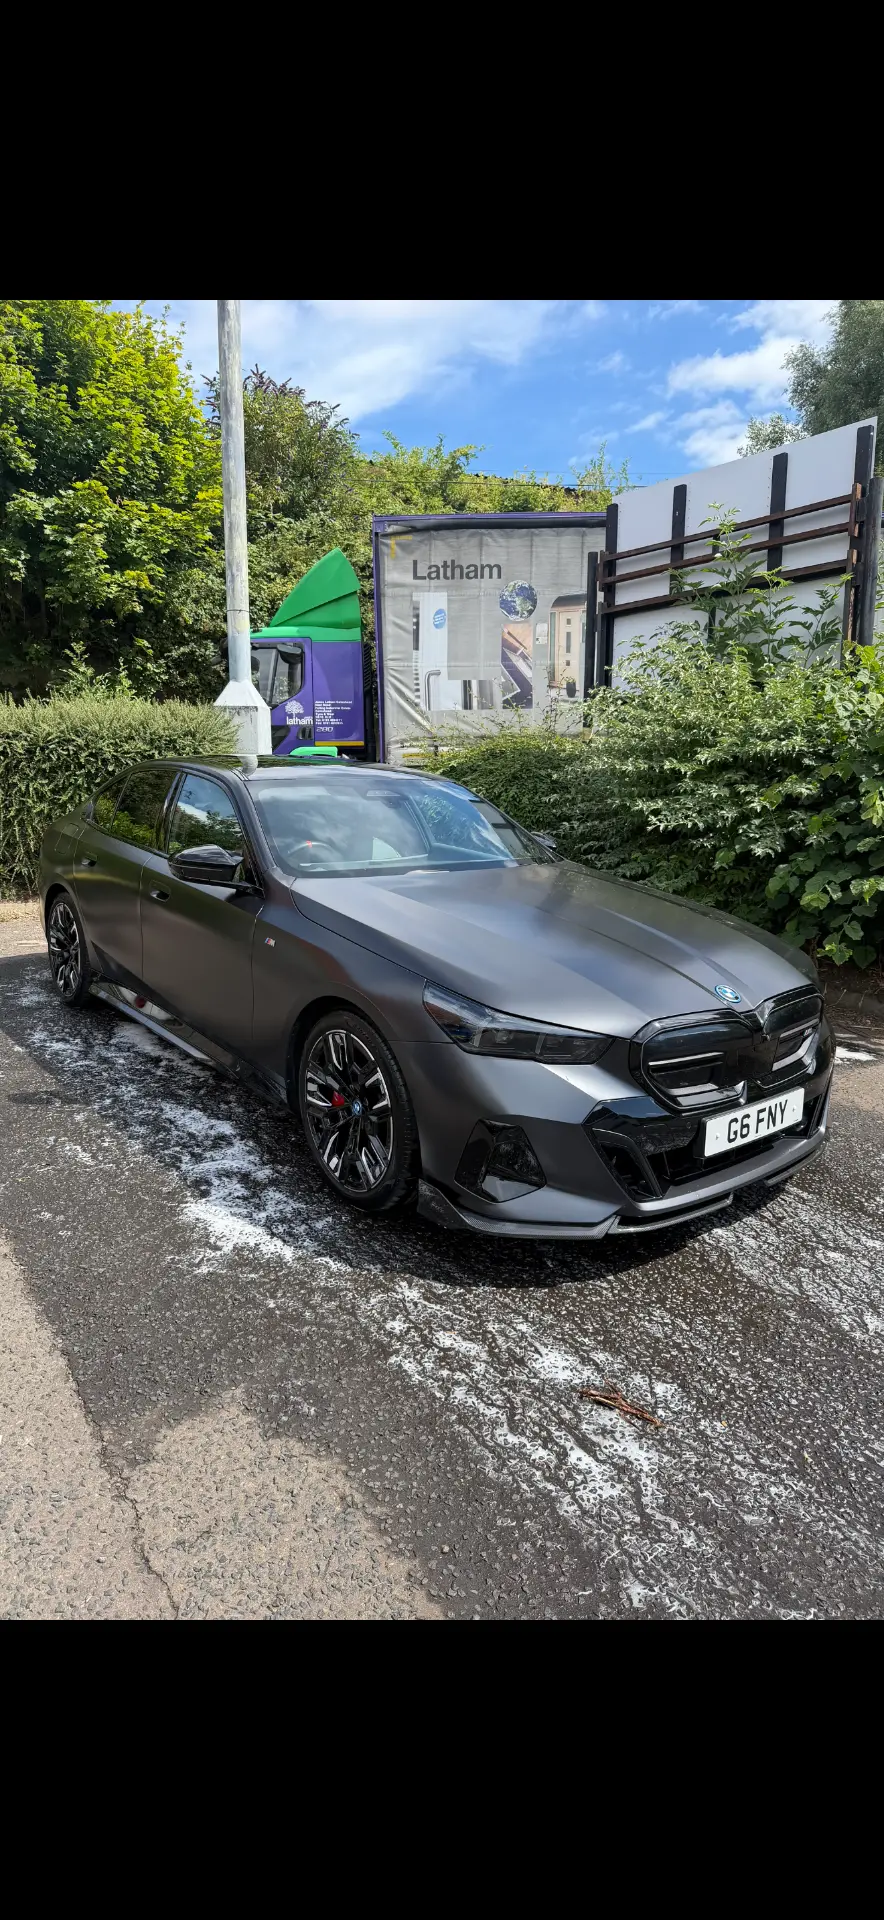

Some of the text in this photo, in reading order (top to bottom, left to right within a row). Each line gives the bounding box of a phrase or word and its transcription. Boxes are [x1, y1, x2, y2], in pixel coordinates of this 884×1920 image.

[413, 560, 502, 580] Latham
[286, 716, 313, 725] latham
[727, 1099, 788, 1143] G6 FNY
